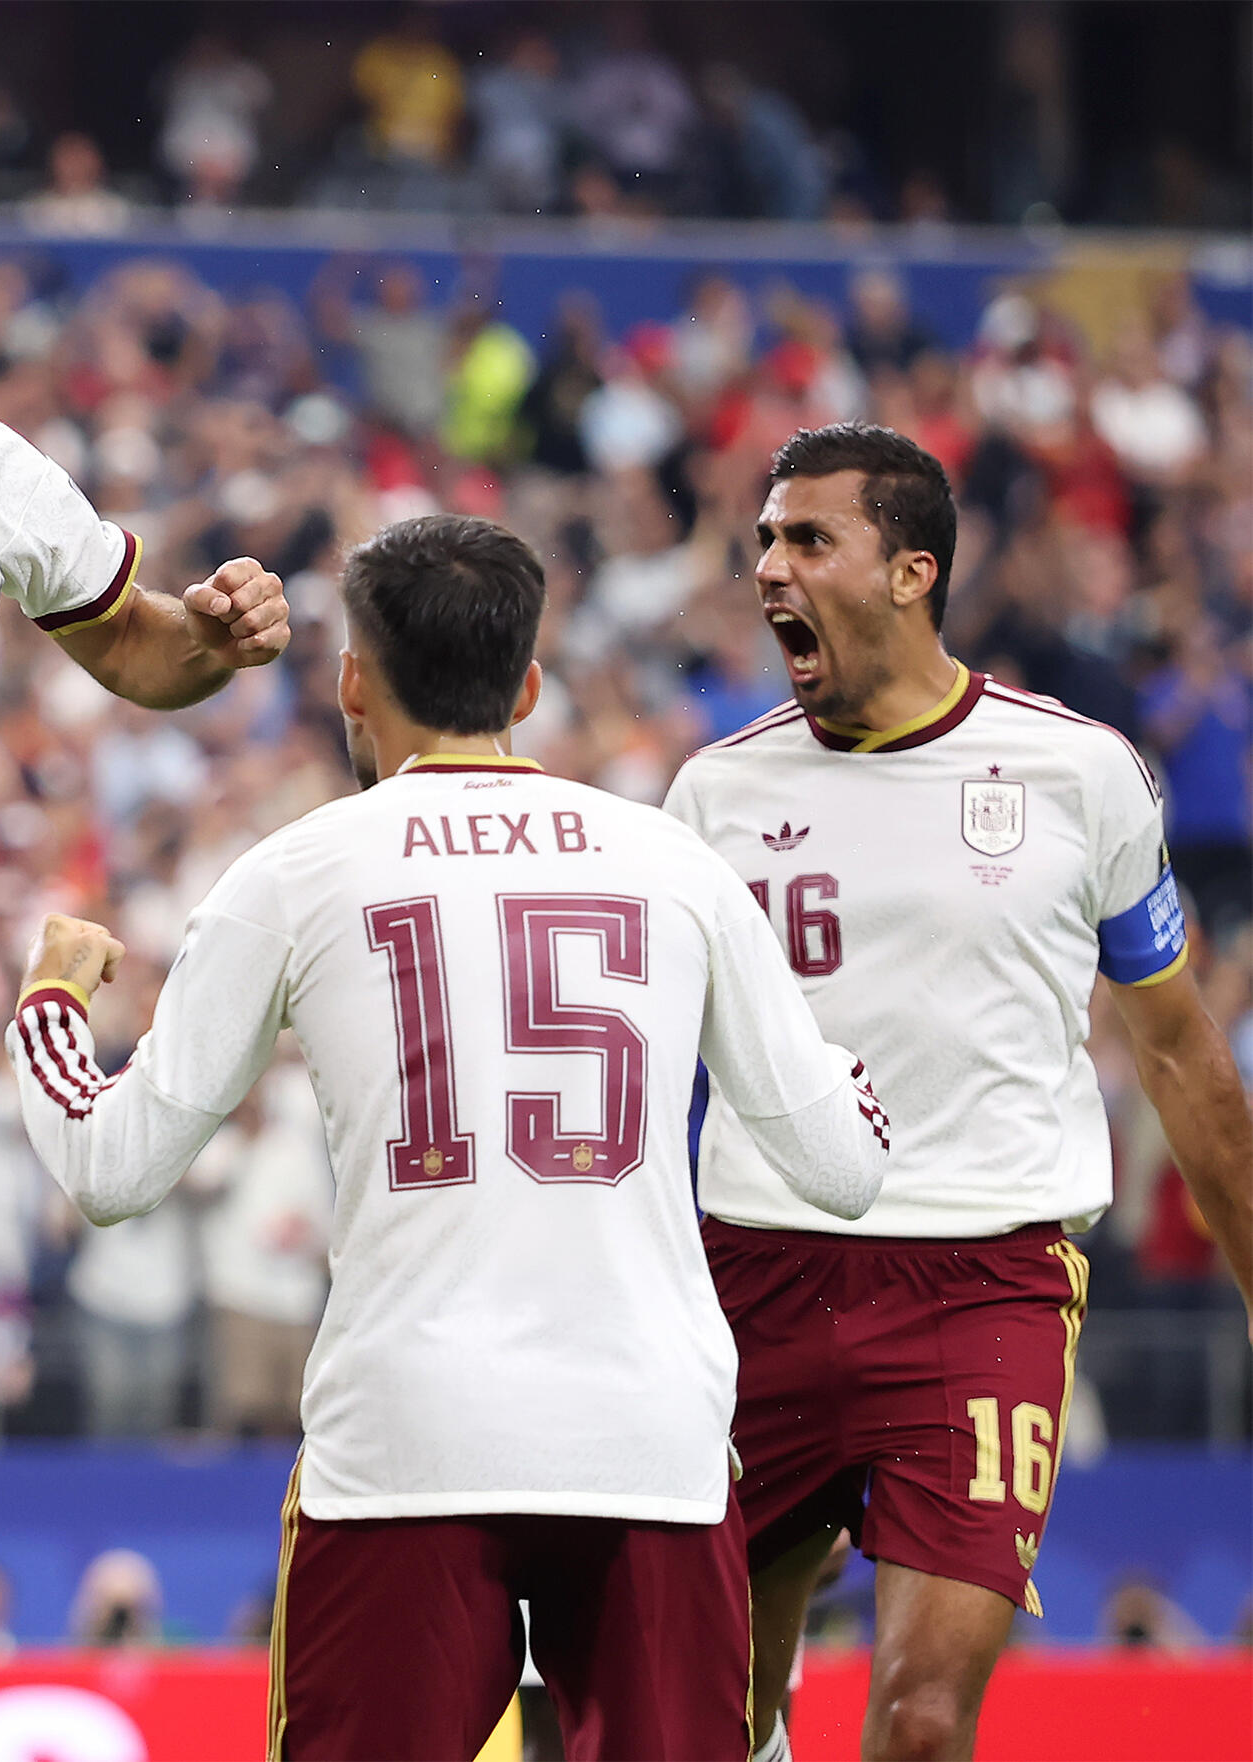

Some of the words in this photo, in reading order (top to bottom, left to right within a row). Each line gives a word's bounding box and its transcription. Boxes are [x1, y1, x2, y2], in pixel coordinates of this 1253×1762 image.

[402, 813, 539, 858] ALEX
[552, 811, 602, 853] B.
[363, 893, 648, 1192] 15
[967, 1397, 1053, 1515] 16
